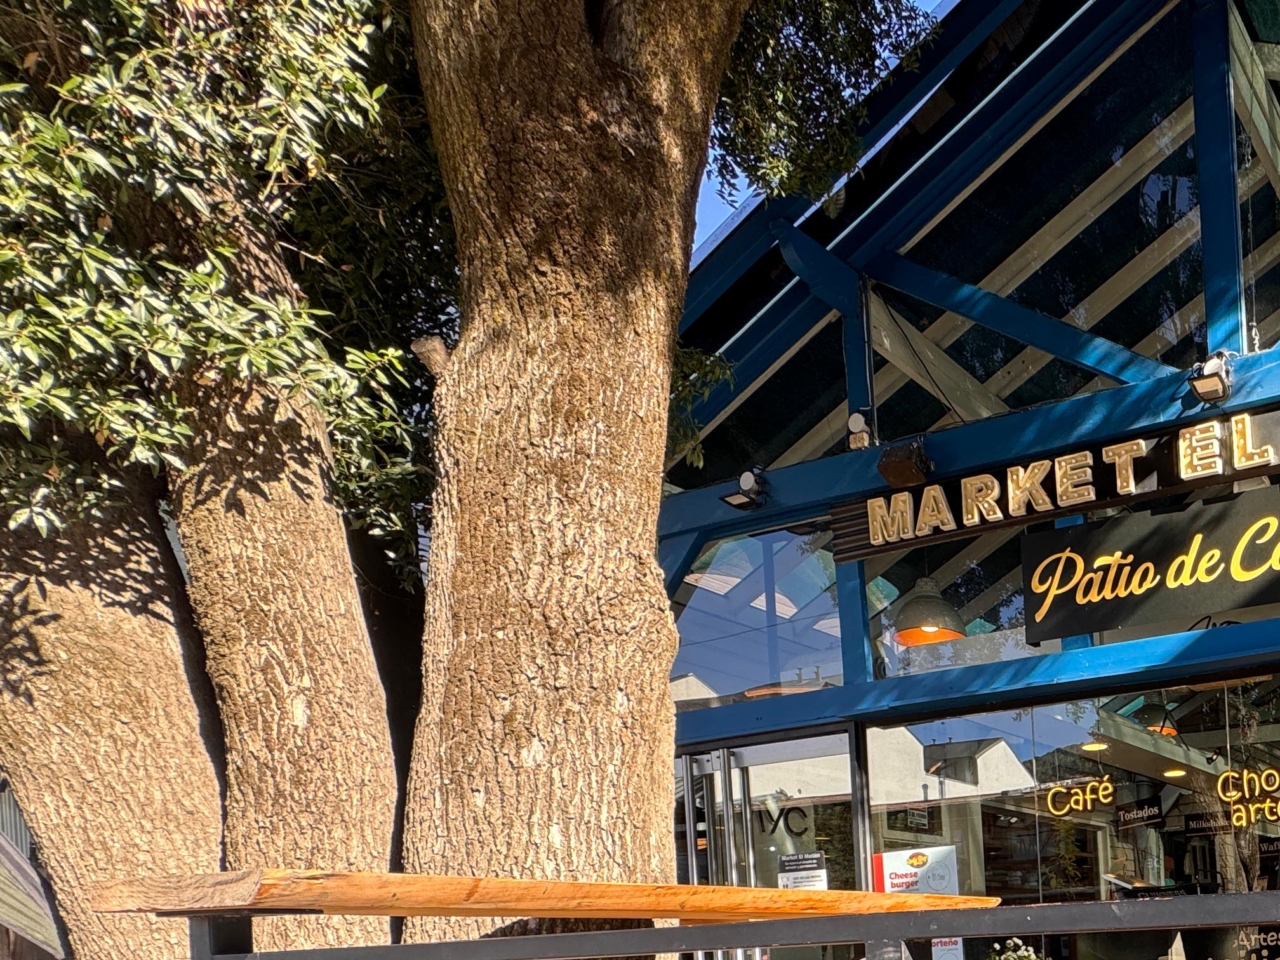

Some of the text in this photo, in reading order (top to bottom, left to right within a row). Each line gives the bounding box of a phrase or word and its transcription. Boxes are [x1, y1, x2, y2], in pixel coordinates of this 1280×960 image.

[868, 438, 1147, 547] MARKET
[1177, 412, 1276, 482] EL
[1030, 543, 1162, 625] Patio
[1166, 530, 1222, 590] de
[1046, 773, 1114, 817] Café
[1118, 805, 1159, 822] Tostados
[889, 872, 919, 880] Cheese
[890, 881, 919, 890] burger
[932, 937, 959, 947] orteño
